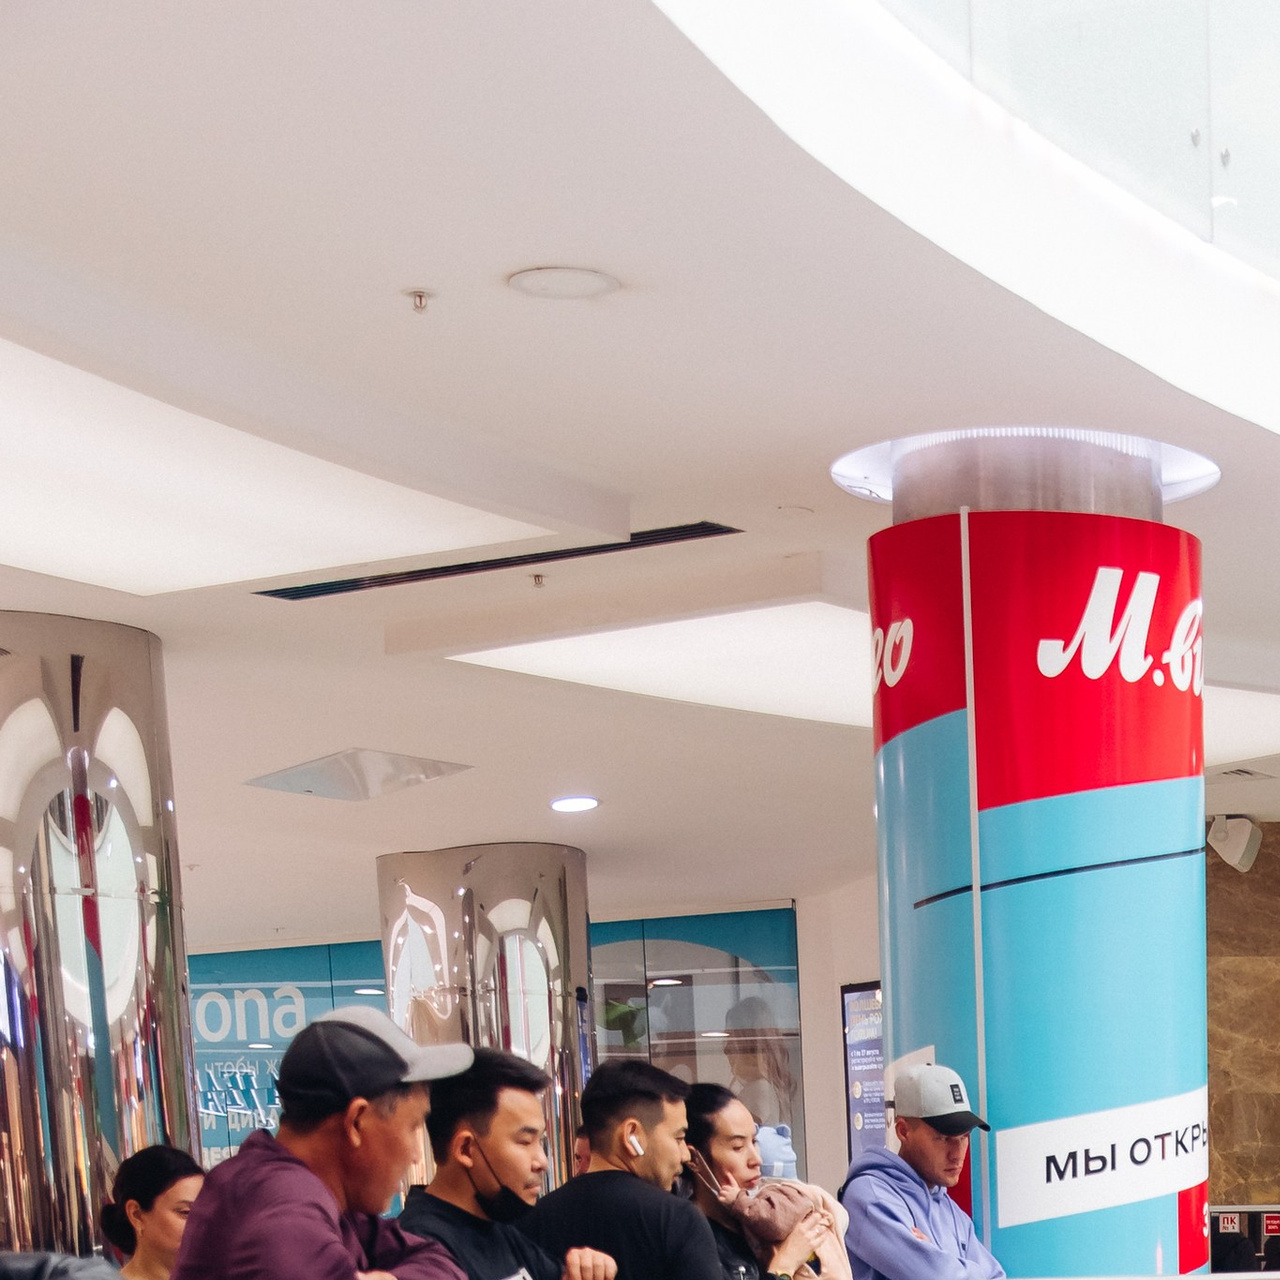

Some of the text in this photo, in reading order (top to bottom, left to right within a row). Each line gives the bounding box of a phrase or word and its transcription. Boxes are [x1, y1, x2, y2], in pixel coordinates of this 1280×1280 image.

[190, 985, 306, 1043] ona
[1045, 1144, 1116, 1184] МЫ
[1222, 1216, 1237, 1226] ПК
